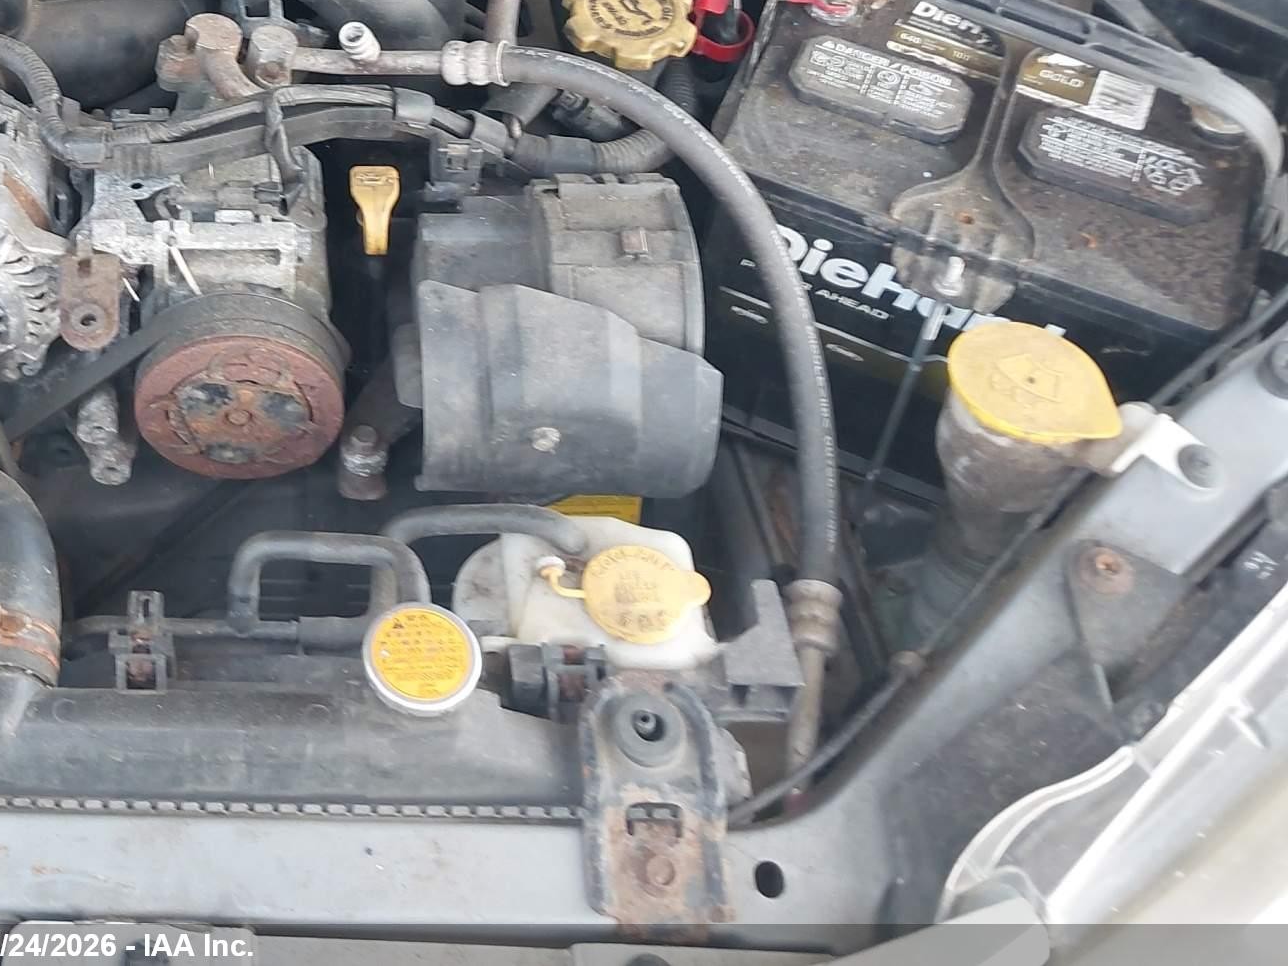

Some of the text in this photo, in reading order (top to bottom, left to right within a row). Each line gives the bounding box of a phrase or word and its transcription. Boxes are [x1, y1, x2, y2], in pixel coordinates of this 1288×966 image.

[835, 44, 890, 68] DANGER
[900, 64, 952, 85] POISON
[1039, 69, 1085, 88] GOLD
[814, 289, 890, 321] AHEAD
